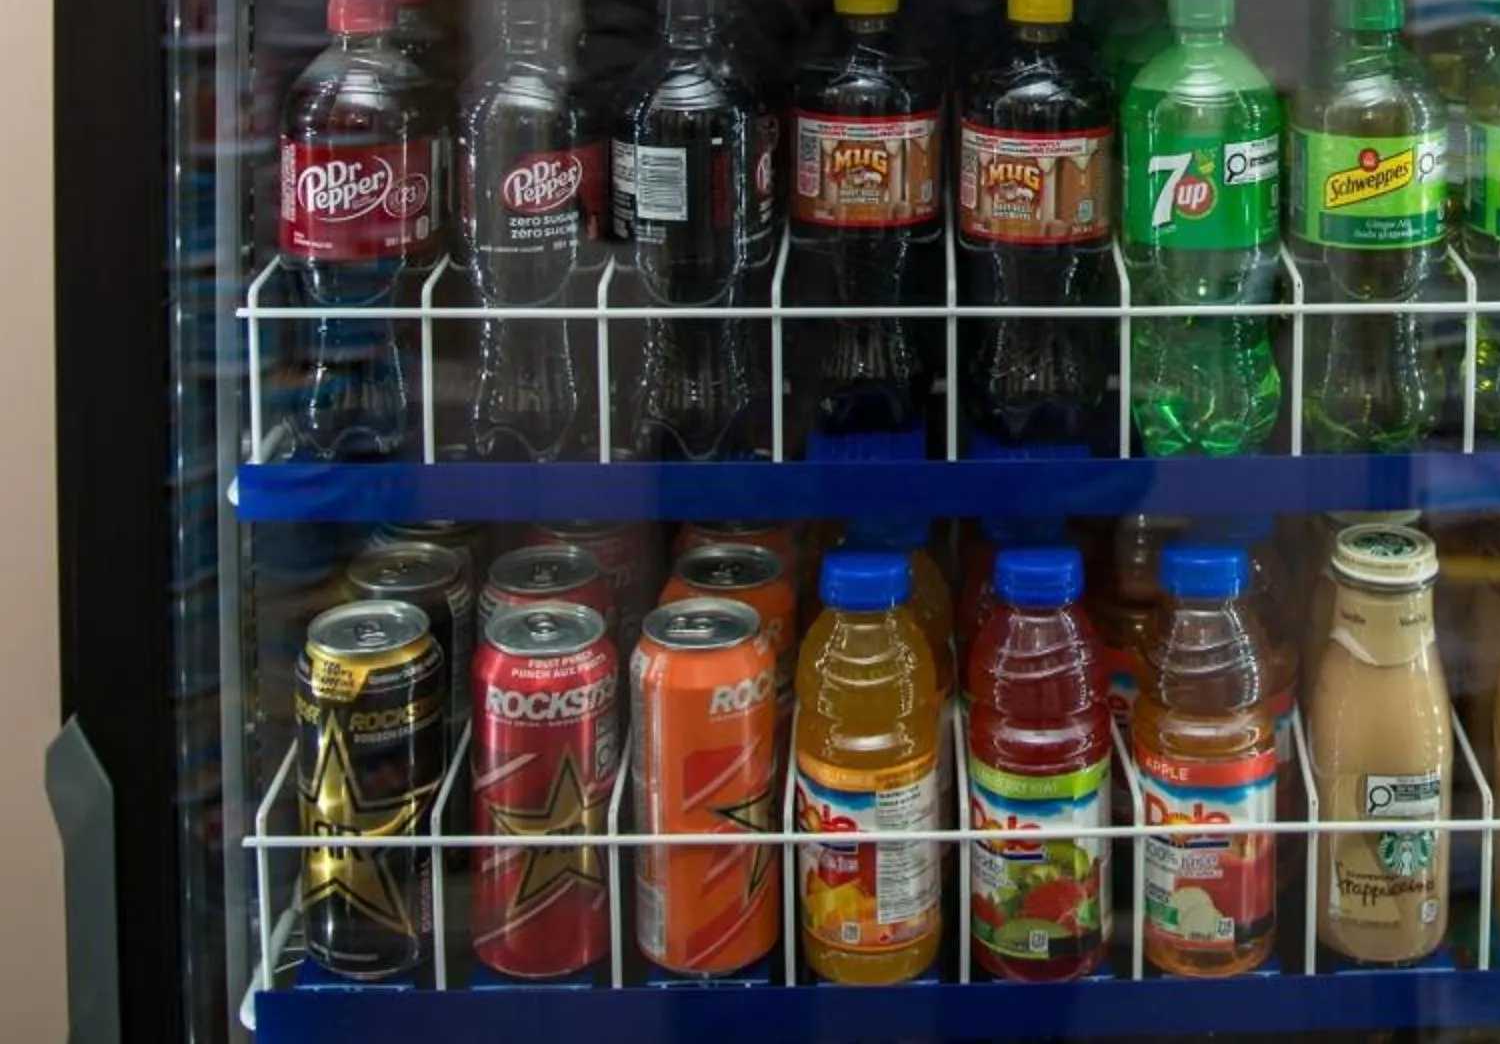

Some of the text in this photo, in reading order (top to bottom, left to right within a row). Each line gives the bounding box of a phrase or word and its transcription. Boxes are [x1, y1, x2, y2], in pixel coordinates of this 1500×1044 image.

[326, 161, 362, 185] Dr
[533, 161, 561, 182] Dr
[833, 148, 888, 174] MUG
[306, 166, 386, 214] Pepper
[513, 166, 578, 206] Pepper
[987, 163, 1041, 191] MUG
[1329, 162, 1409, 202] Schweppes
[709, 669, 773, 714] ROC
[1146, 757, 1189, 781] APPLE
